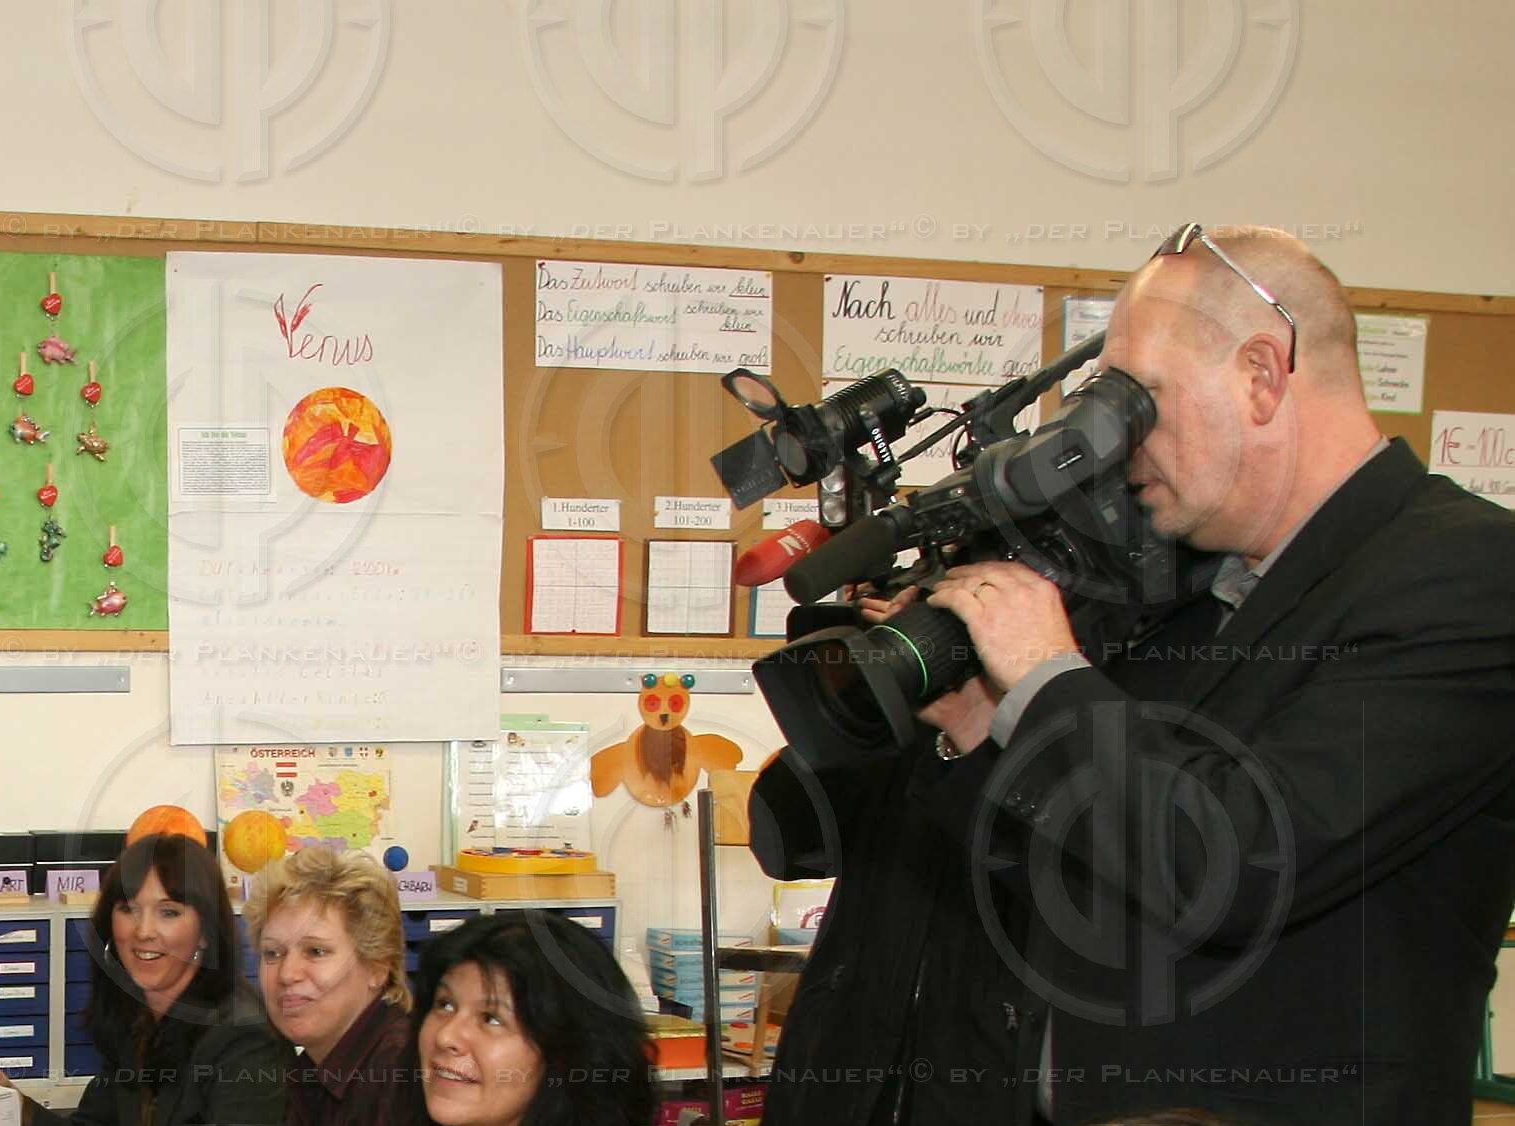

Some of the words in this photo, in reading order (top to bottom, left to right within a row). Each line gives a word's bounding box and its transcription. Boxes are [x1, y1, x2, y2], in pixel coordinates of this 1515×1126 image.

[538, 267, 568, 290] Das
[643, 272, 702, 293] schreiben
[537, 300, 563, 323] Das
[685, 300, 739, 317] schreiben
[832, 280, 895, 320] Nach
[905, 281, 957, 322] alles
[964, 289, 998, 327] und
[274, 284, 373, 366] Venus
[875, 321, 962, 345] schreiben
[969, 332, 1006, 347] wir
[537, 335, 564, 358] Das
[565, 334, 655, 365] Hauptwort
[656, 343, 710, 363] schreiben
[552, 502, 609, 514] 1.Hunderter
[664, 500, 720, 513] 2.Hunderter
[567, 516, 595, 528] 1-100
[674, 515, 712, 527] 101-200
[250, 747, 316, 758] ÖSTERREICH
[57, 875, 85, 892] MIR
